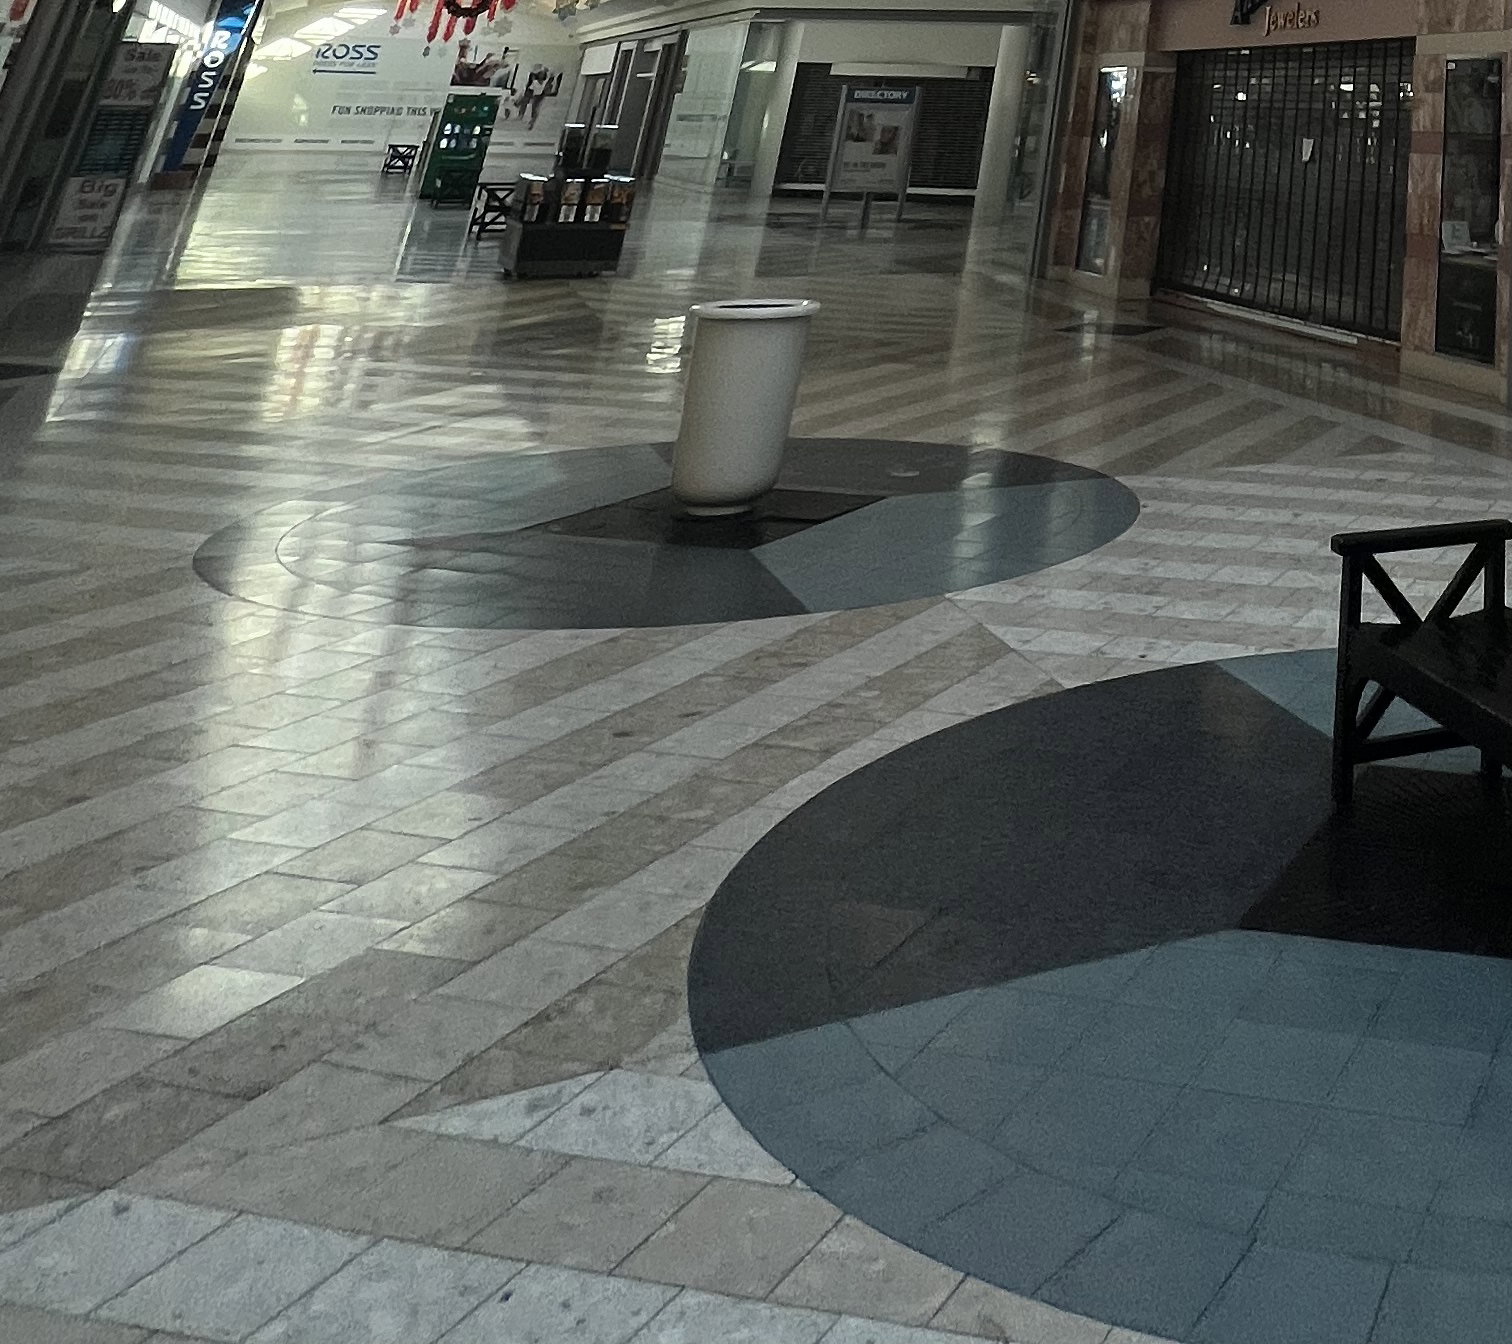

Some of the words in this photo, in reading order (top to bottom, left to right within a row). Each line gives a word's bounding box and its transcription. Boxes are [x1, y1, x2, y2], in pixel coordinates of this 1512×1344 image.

[1264, 2, 1320, 37] Jewelers
[315, 43, 382, 60] ROSS
[190, 30, 232, 110] ROSS
[853, 89, 909, 100] DIRECTORY
[331, 105, 352, 115] FUN
[354, 105, 404, 116] SHOPPING
[406, 106, 428, 116] THIS
[81, 179, 117, 198] Big
